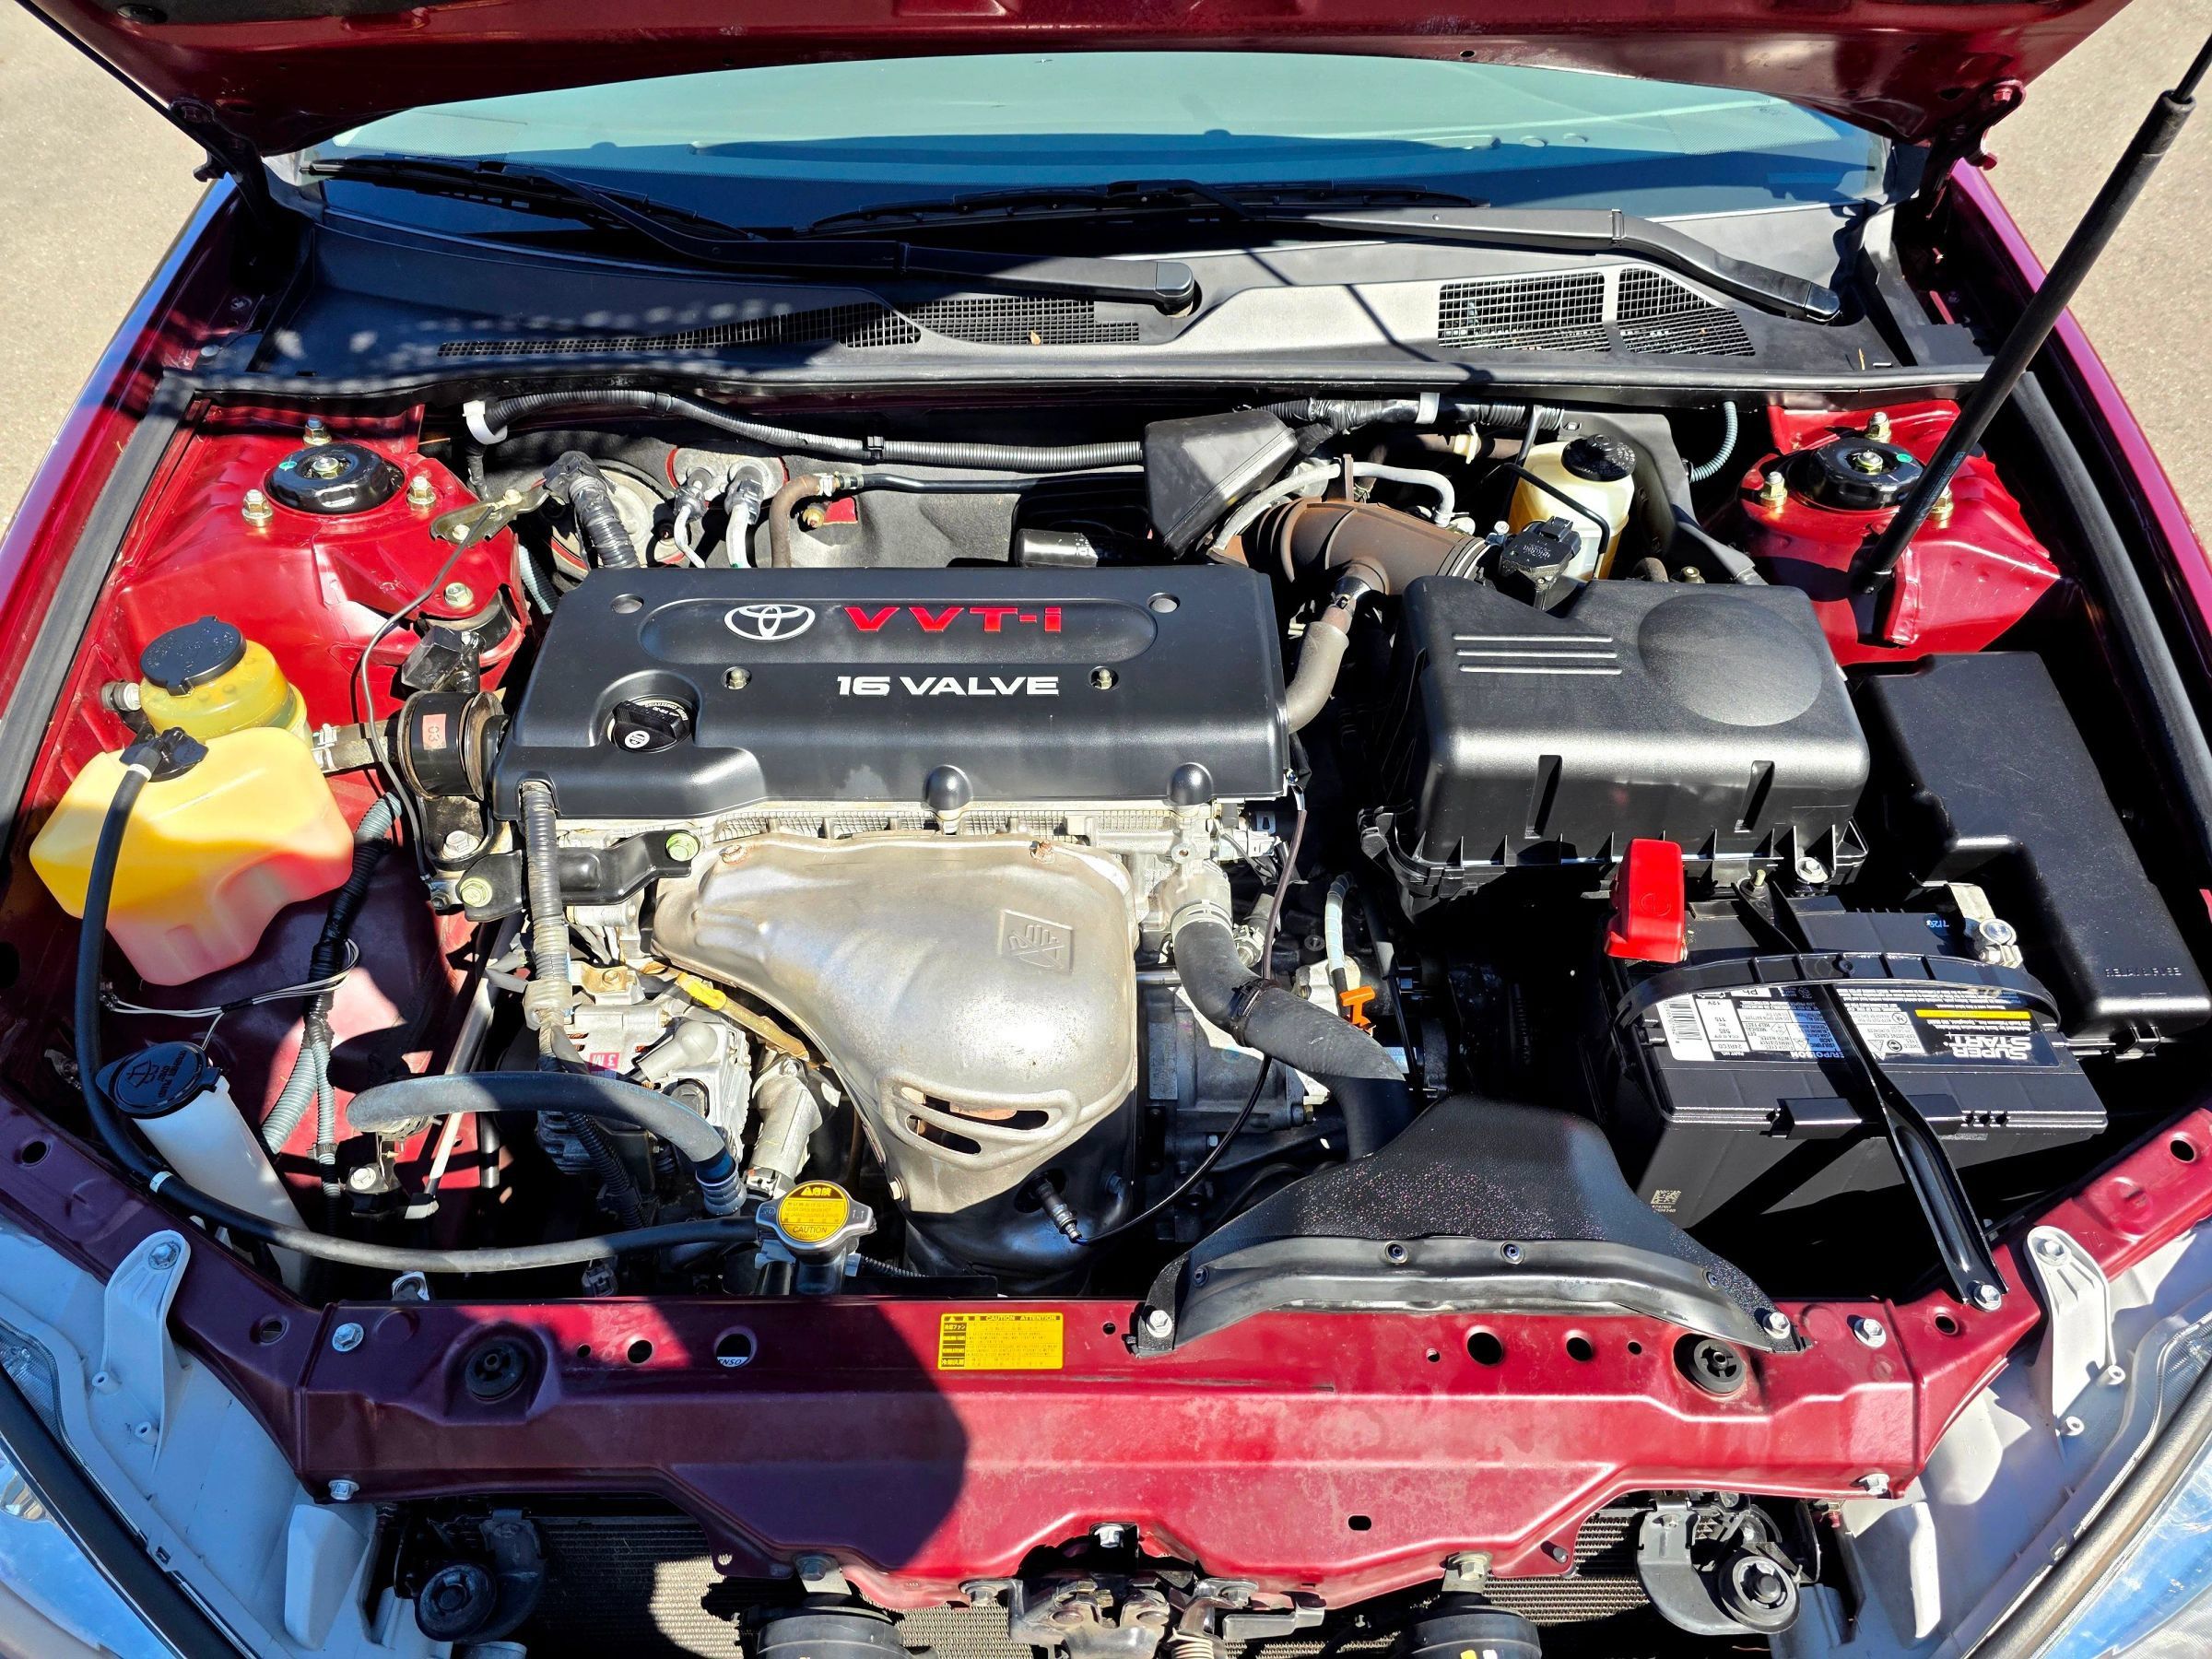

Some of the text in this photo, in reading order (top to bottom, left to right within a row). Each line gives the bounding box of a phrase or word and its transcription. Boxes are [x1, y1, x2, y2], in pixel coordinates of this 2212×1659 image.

[843, 606, 1062, 632] VVT-i
[837, 676, 1060, 696] 16 VALVE
[1948, 1036, 2032, 1051] START
[1951, 1046, 2028, 1060] SUPER
